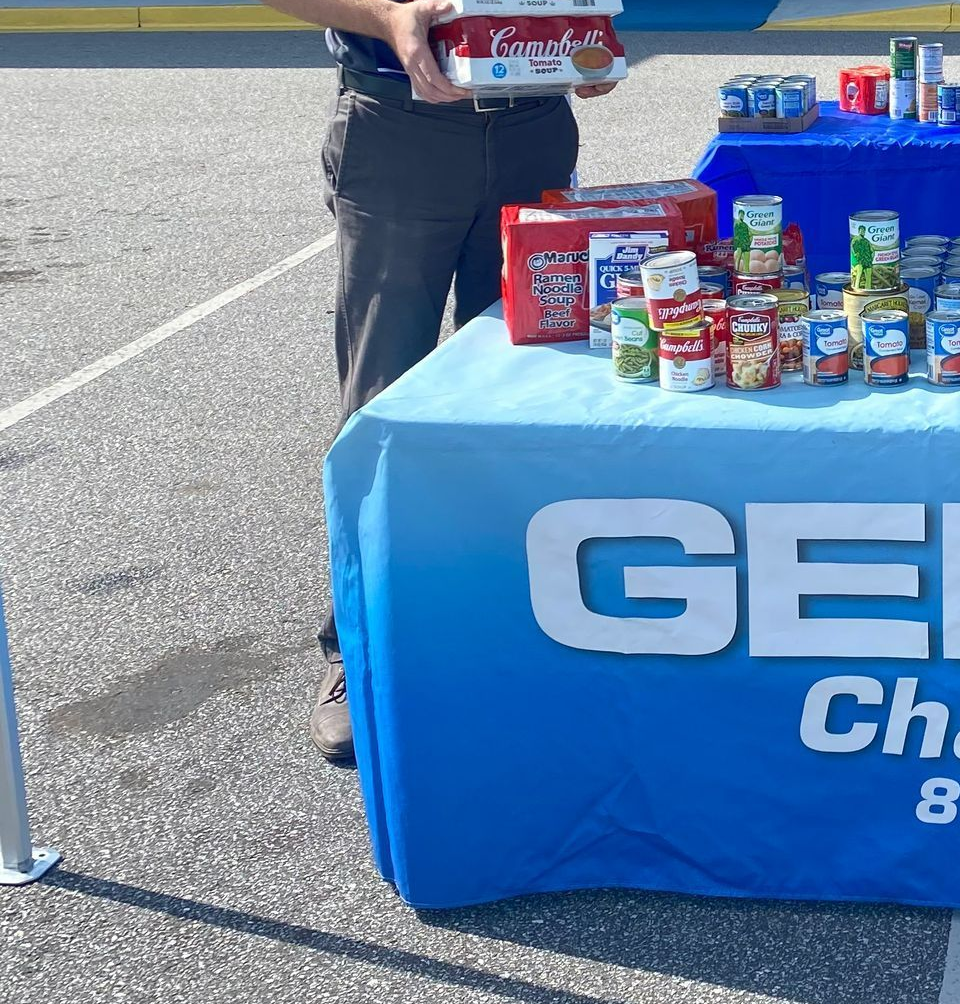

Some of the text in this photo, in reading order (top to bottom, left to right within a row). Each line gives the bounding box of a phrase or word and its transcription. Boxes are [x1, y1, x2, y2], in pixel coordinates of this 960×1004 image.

[528, 58, 562, 67] Tomato
[494, 66, 506, 74] 12
[746, 210, 774, 219] Green
[749, 218, 775, 227] Giant
[867, 225, 895, 234] Green
[871, 233, 895, 242] Giant
[622, 246, 638, 254] Jim
[543, 250, 590, 264] Maruc
[616, 252, 645, 261] Dandy
[533, 274, 581, 284] Ramen
[533, 283, 582, 295] Noodle
[539, 295, 575, 306] Soup
[544, 308, 571, 319] Beef
[539, 318, 575, 329] Flavor
[731, 321, 768, 333] CHUNKY
[659, 337, 704, 354] Campbell's
[876, 340, 903, 348] Tomato
[730, 349, 773, 360] CHOWDER
